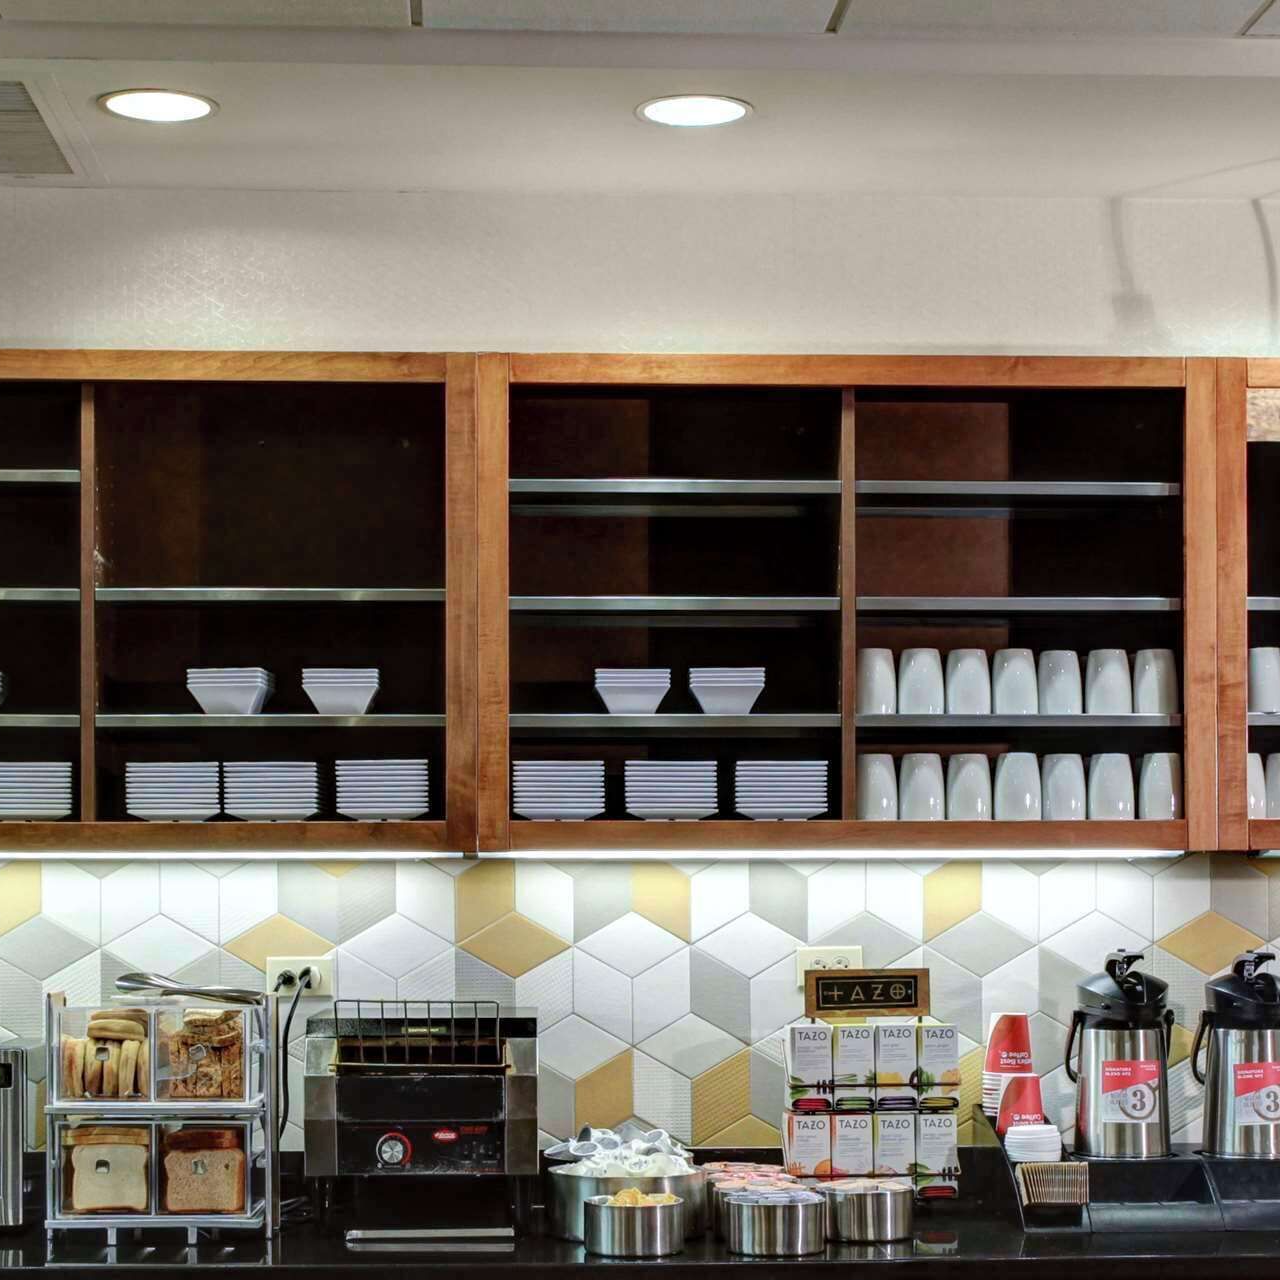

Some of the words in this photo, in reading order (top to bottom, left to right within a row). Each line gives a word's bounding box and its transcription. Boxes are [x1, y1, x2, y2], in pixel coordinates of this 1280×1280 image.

[798, 1031, 828, 1041] TAZO
[840, 1029, 870, 1039] TAZO
[882, 1028, 912, 1039] TAZO
[925, 1028, 954, 1039] TAZO
[1131, 1089, 1146, 1111] 3
[1266, 1090, 1280, 1112] 3
[796, 1120, 826, 1130] TAZO
[839, 1119, 868, 1129] TAZO
[881, 1119, 911, 1129] TAZO
[923, 1118, 953, 1128] TAZO
